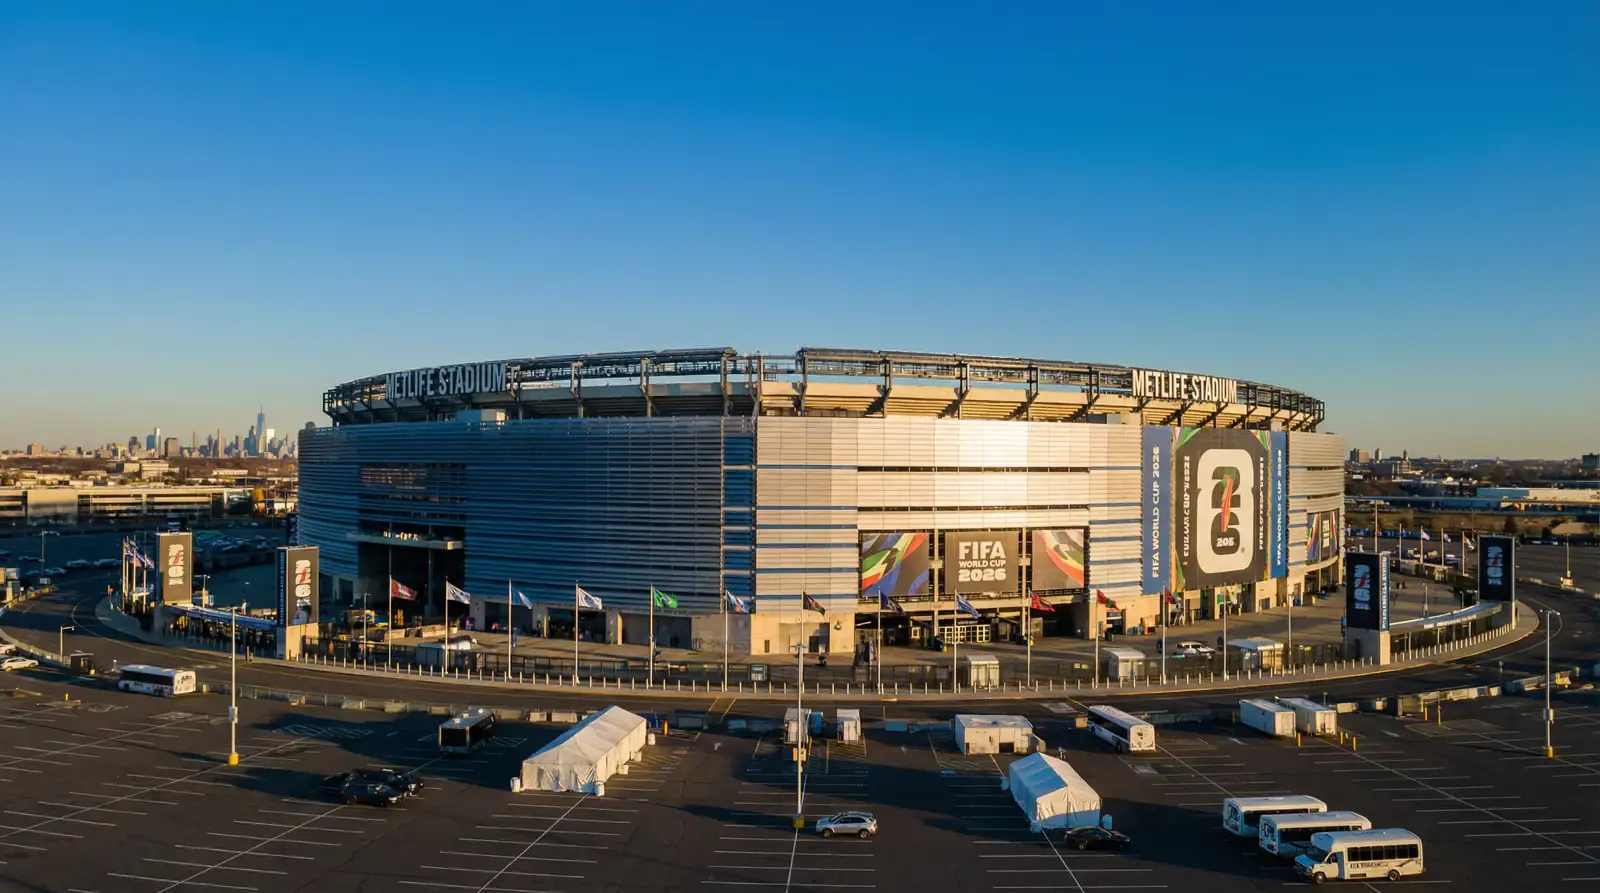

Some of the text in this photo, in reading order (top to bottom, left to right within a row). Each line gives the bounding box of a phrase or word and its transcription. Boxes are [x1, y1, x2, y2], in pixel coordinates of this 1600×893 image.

[386, 362, 506, 400] METLIFE STADIUM
[1132, 369, 1237, 404] METLIFE STADIUM
[1152, 446, 1160, 578] FIFA WORLD CUP 2026
[959, 541, 1006, 559] FIFA
[958, 568, 1007, 582] 2026
[959, 559, 1006, 568] WORLD CUP
